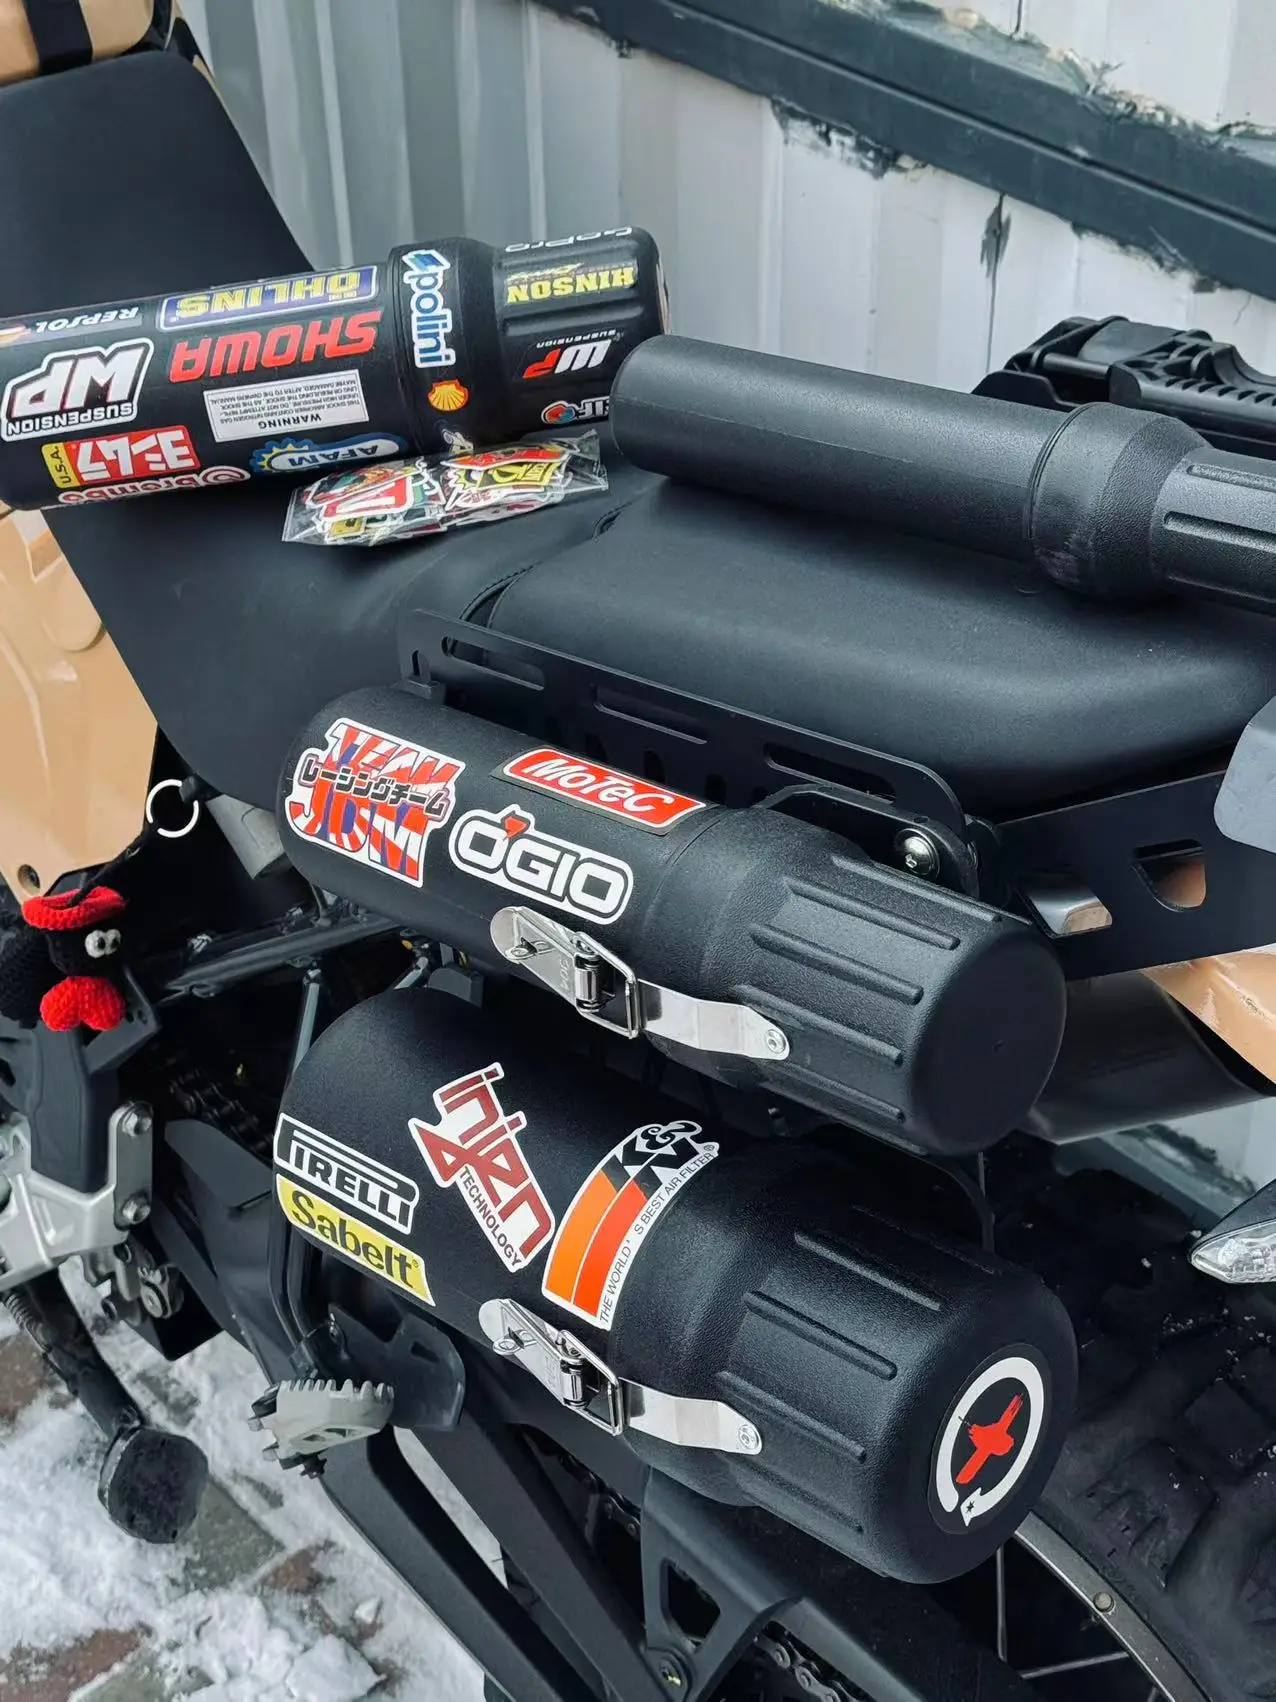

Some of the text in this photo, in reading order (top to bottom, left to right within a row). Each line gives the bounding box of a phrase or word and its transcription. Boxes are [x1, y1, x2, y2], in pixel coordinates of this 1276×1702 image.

[507, 267, 635, 304] HINSON
[35, 307, 140, 334] REPSOL
[408, 273, 451, 363] polini
[536, 329, 617, 348] SUSPENSION
[169, 310, 383, 384] SHOWA
[522, 340, 612, 379] WP
[11, 344, 144, 419] WP
[7, 402, 133, 436] SUSPENSION
[258, 413, 321, 430] WARNING
[50, 445, 72, 486] U.S.A.
[77, 429, 196, 482] ヨシムラ
[288, 444, 379, 466] AFAM
[61, 475, 200, 503] brembo
[325, 721, 461, 792] TEAM
[301, 757, 447, 817] レーシングチーム
[522, 758, 676, 813] MoTeC
[289, 777, 429, 882] JDM
[276, 1118, 416, 1229] PIRELLI
[601, 1121, 701, 1201] K&N
[458, 1165, 523, 1268] TECHNOLOGY
[600, 1295, 615, 1324] THE
[641, 1193, 666, 1225] BEST
[664, 1176, 682, 1196] AIR
[679, 1152, 715, 1179] FILTER
